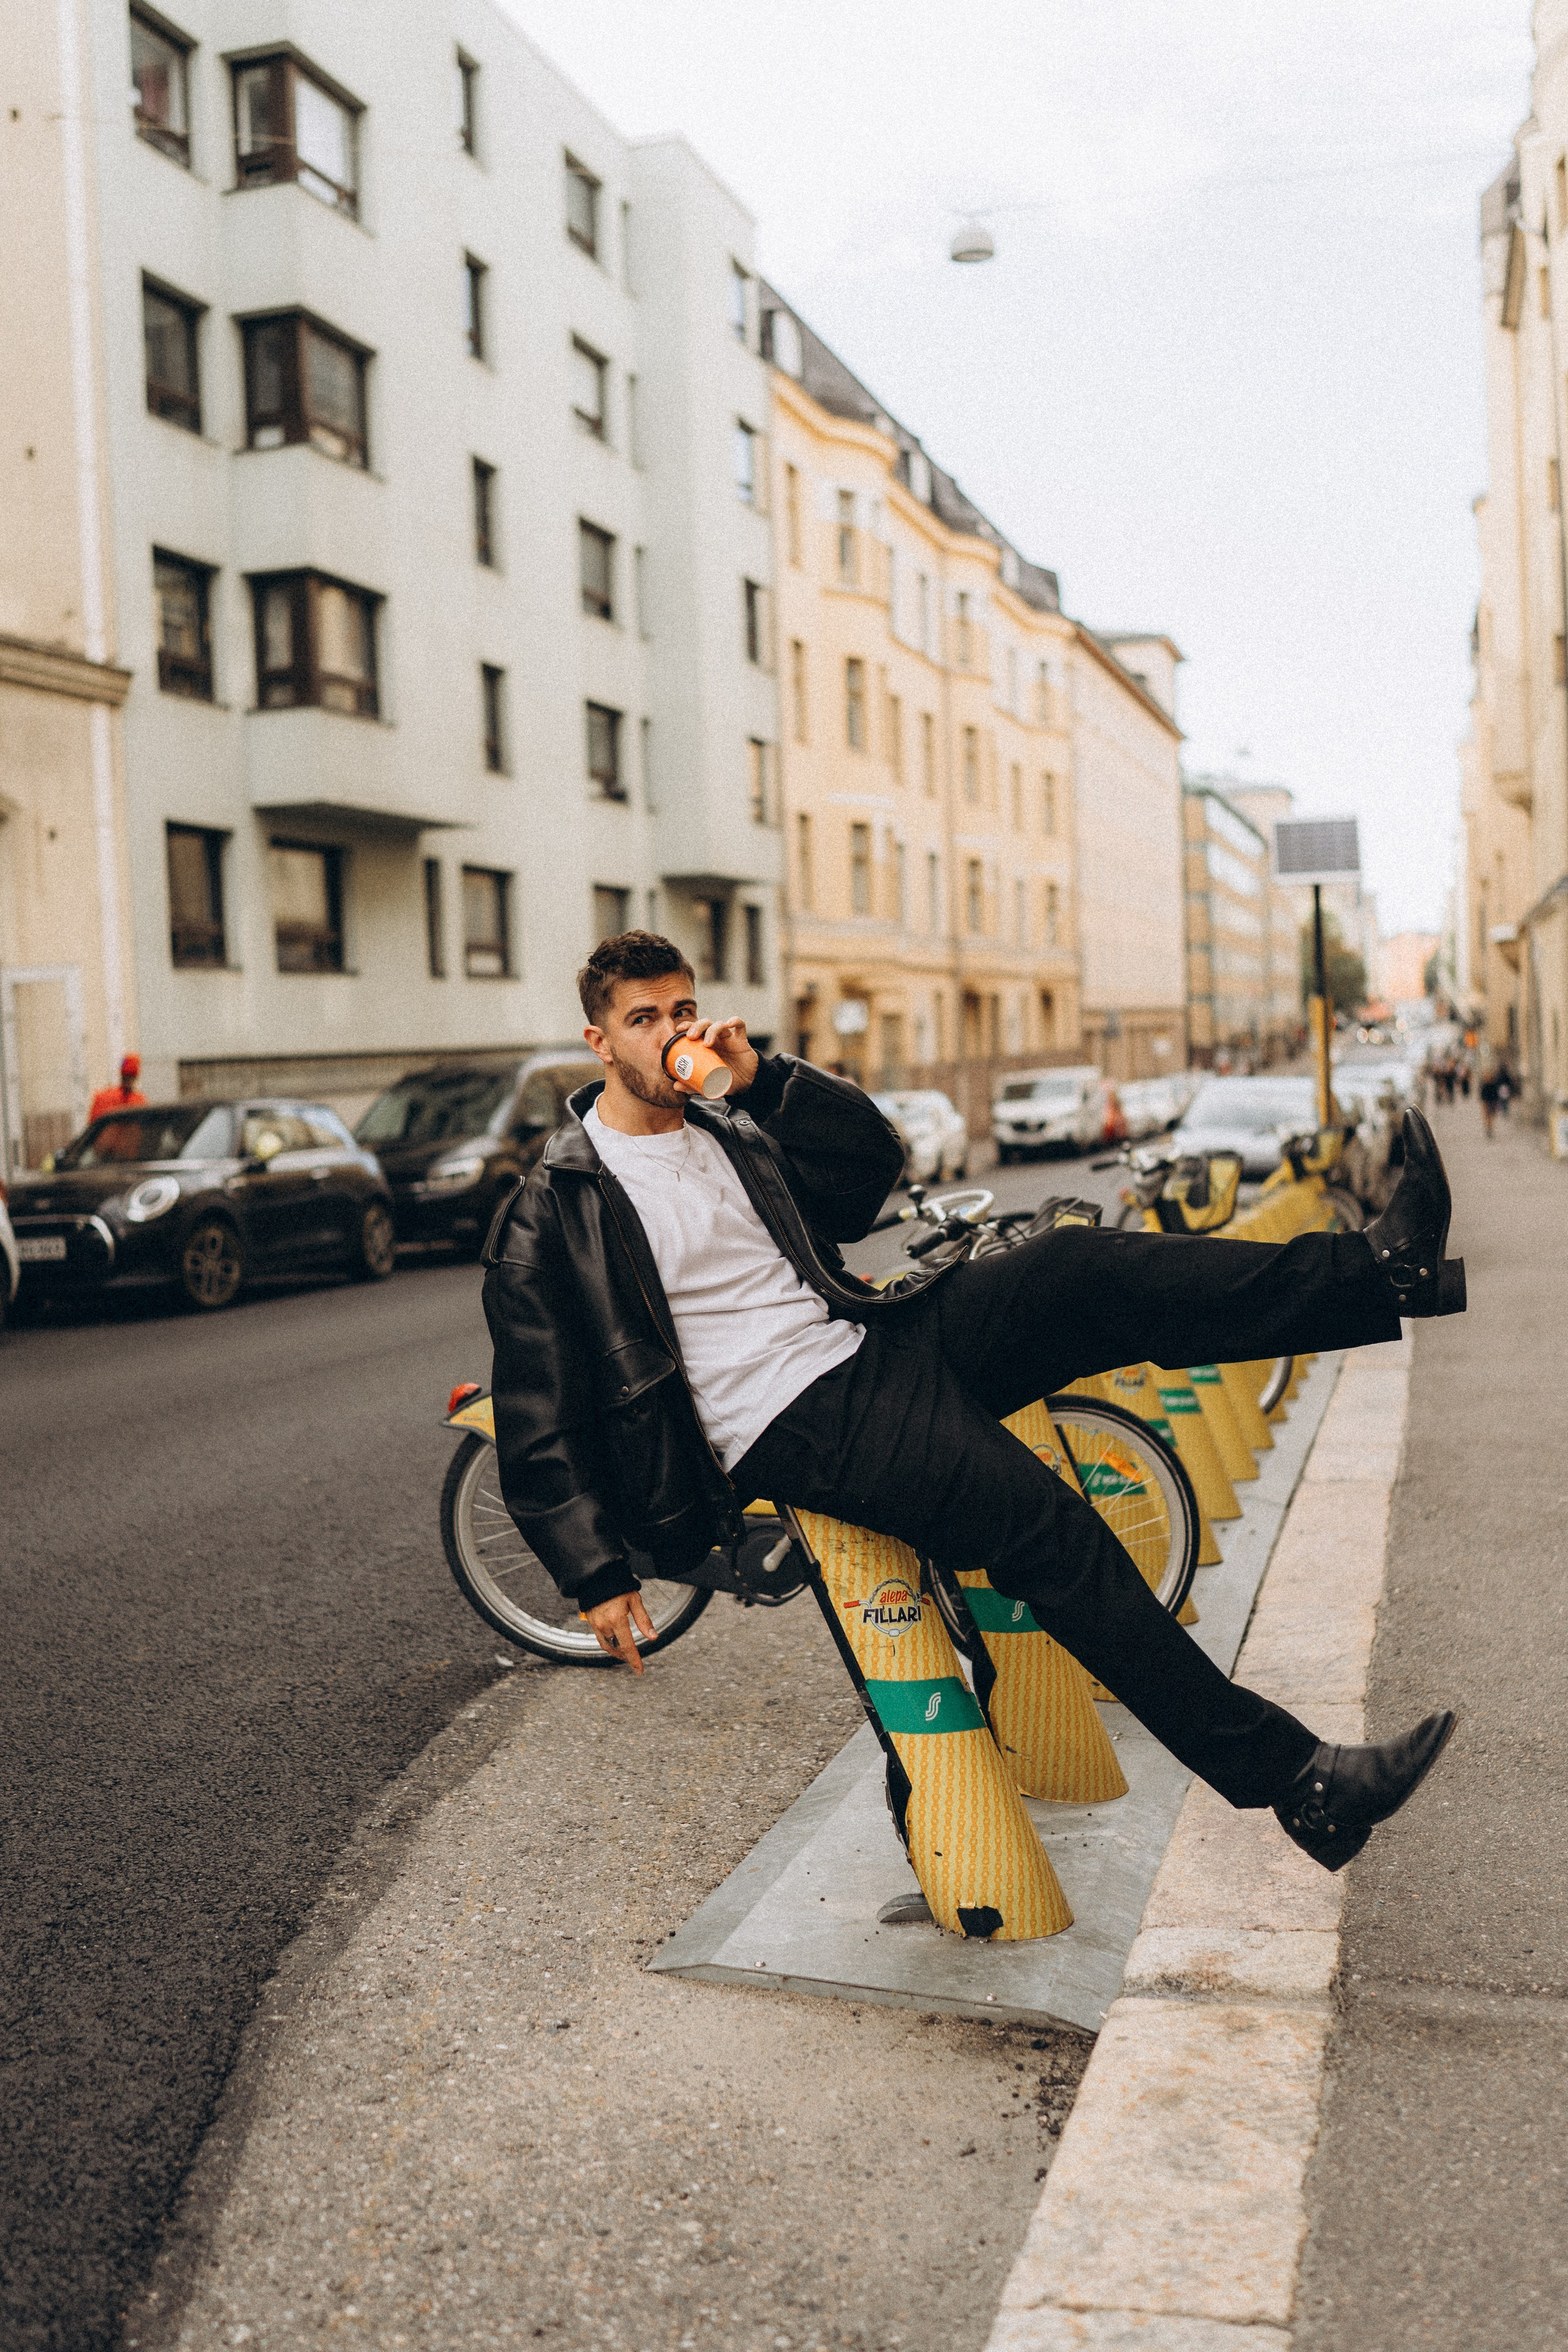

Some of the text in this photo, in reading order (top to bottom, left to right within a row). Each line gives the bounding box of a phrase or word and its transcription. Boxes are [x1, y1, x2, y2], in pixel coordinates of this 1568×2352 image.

[677, 1057, 689, 1076] DASH
[879, 1589, 907, 1604] alepa
[862, 1605, 921, 1623] FILLARI
